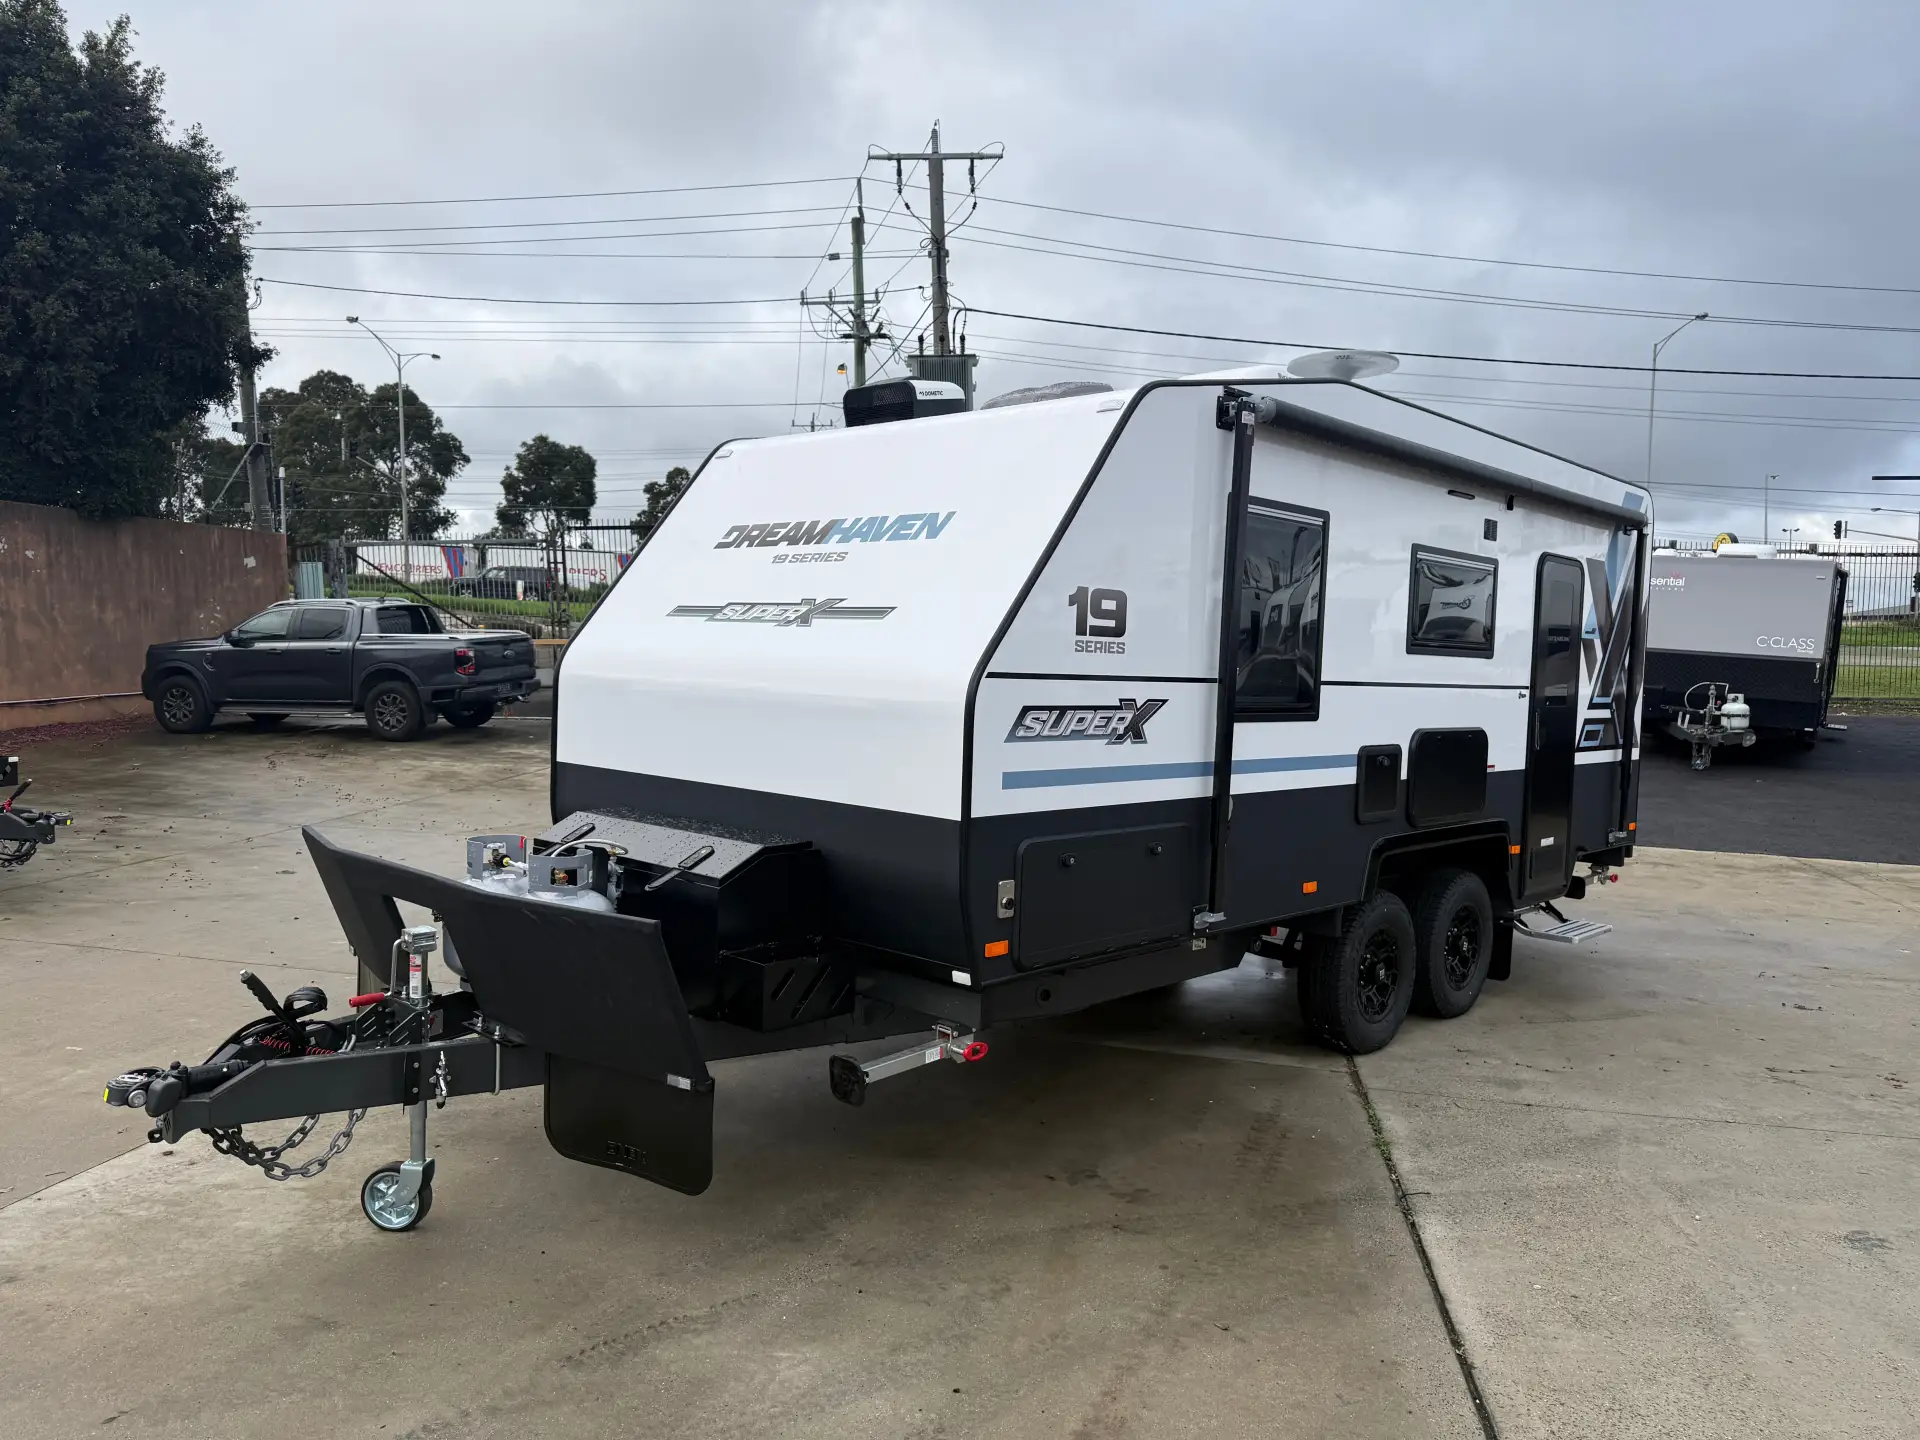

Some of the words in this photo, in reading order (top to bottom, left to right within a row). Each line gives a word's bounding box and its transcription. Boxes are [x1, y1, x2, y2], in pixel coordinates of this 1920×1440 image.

[713, 511, 957, 549] DREAMHAVEN
[771, 554, 789, 564] 19
[788, 552, 849, 564] SERIES
[366, 563, 442, 574] CEMCURIERS
[1068, 586, 1128, 638] 19
[1074, 639, 1126, 655] SERIES
